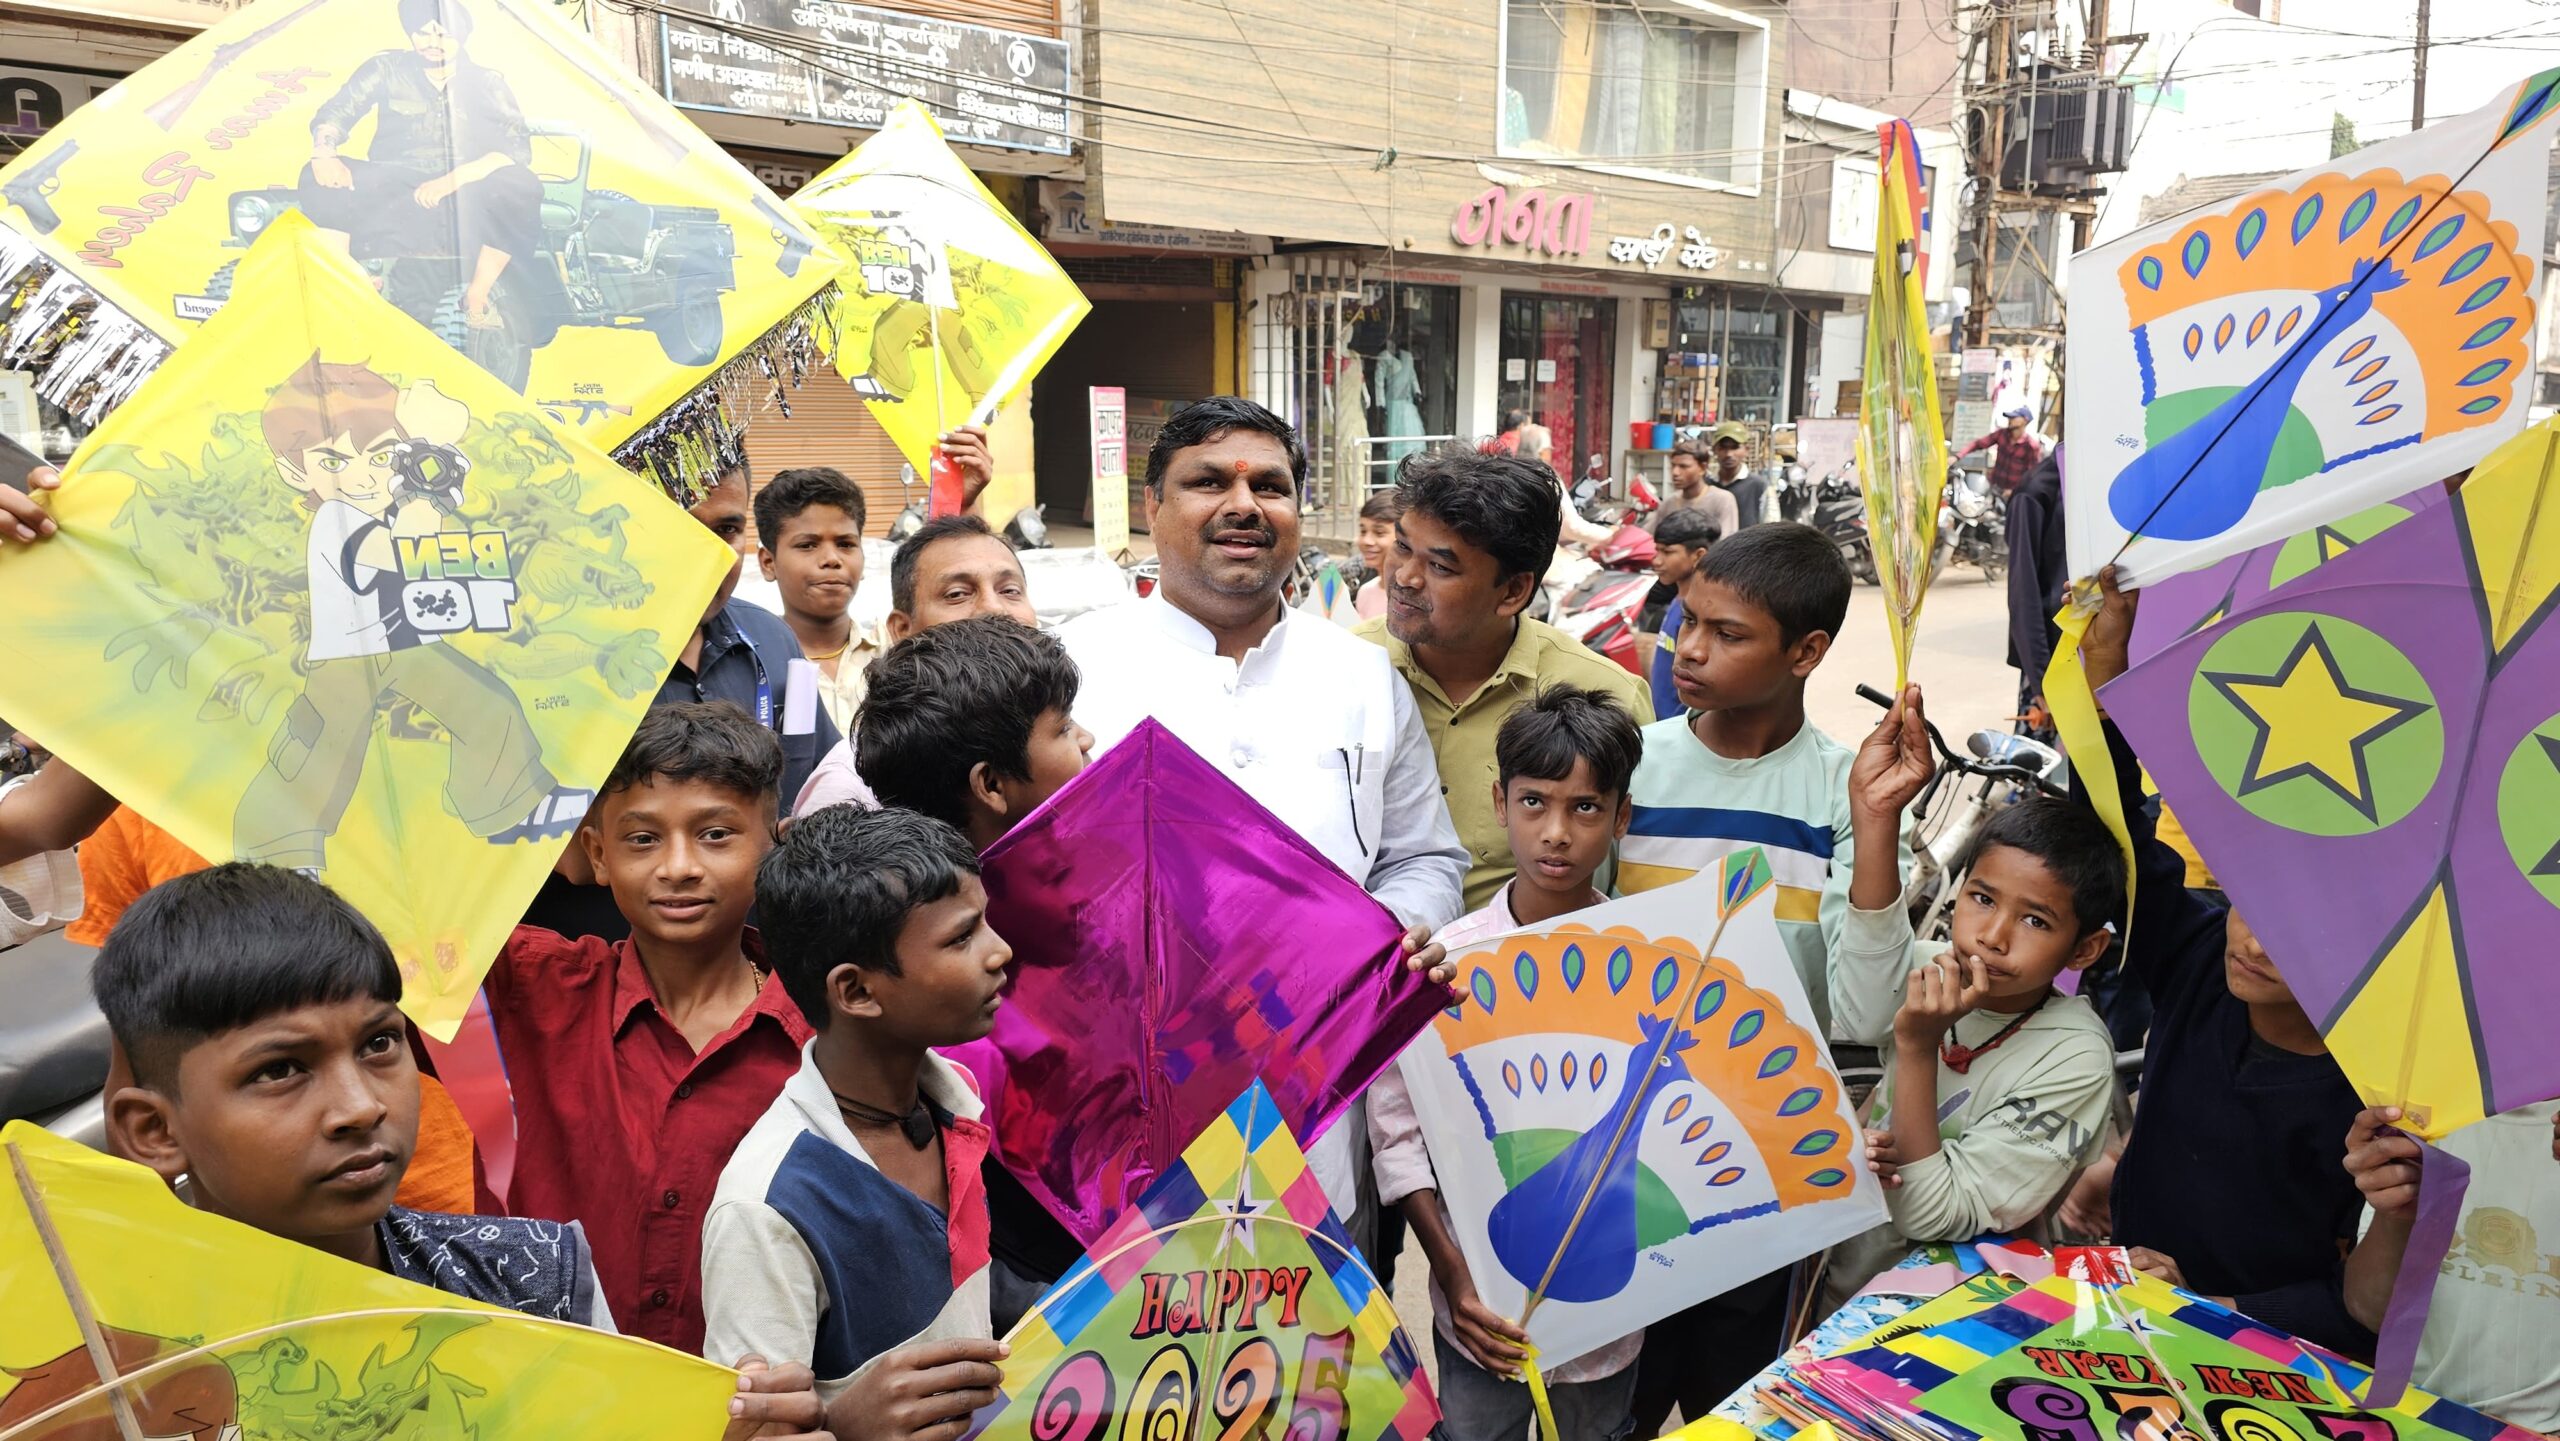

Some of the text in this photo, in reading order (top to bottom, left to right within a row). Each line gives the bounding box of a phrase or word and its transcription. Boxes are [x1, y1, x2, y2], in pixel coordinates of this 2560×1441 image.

[669, 26, 721, 55] मनोज
[1452, 186, 1594, 257] जनता
[1608, 222, 1676, 269] साड़ी
[860, 240, 911, 268] BEN
[861, 266, 914, 294] 10
[760, 695, 769, 721] POLICE
[1130, 1265, 1313, 1340] HAPPY
[2020, 1345, 2331, 1405] NEW YEAR
